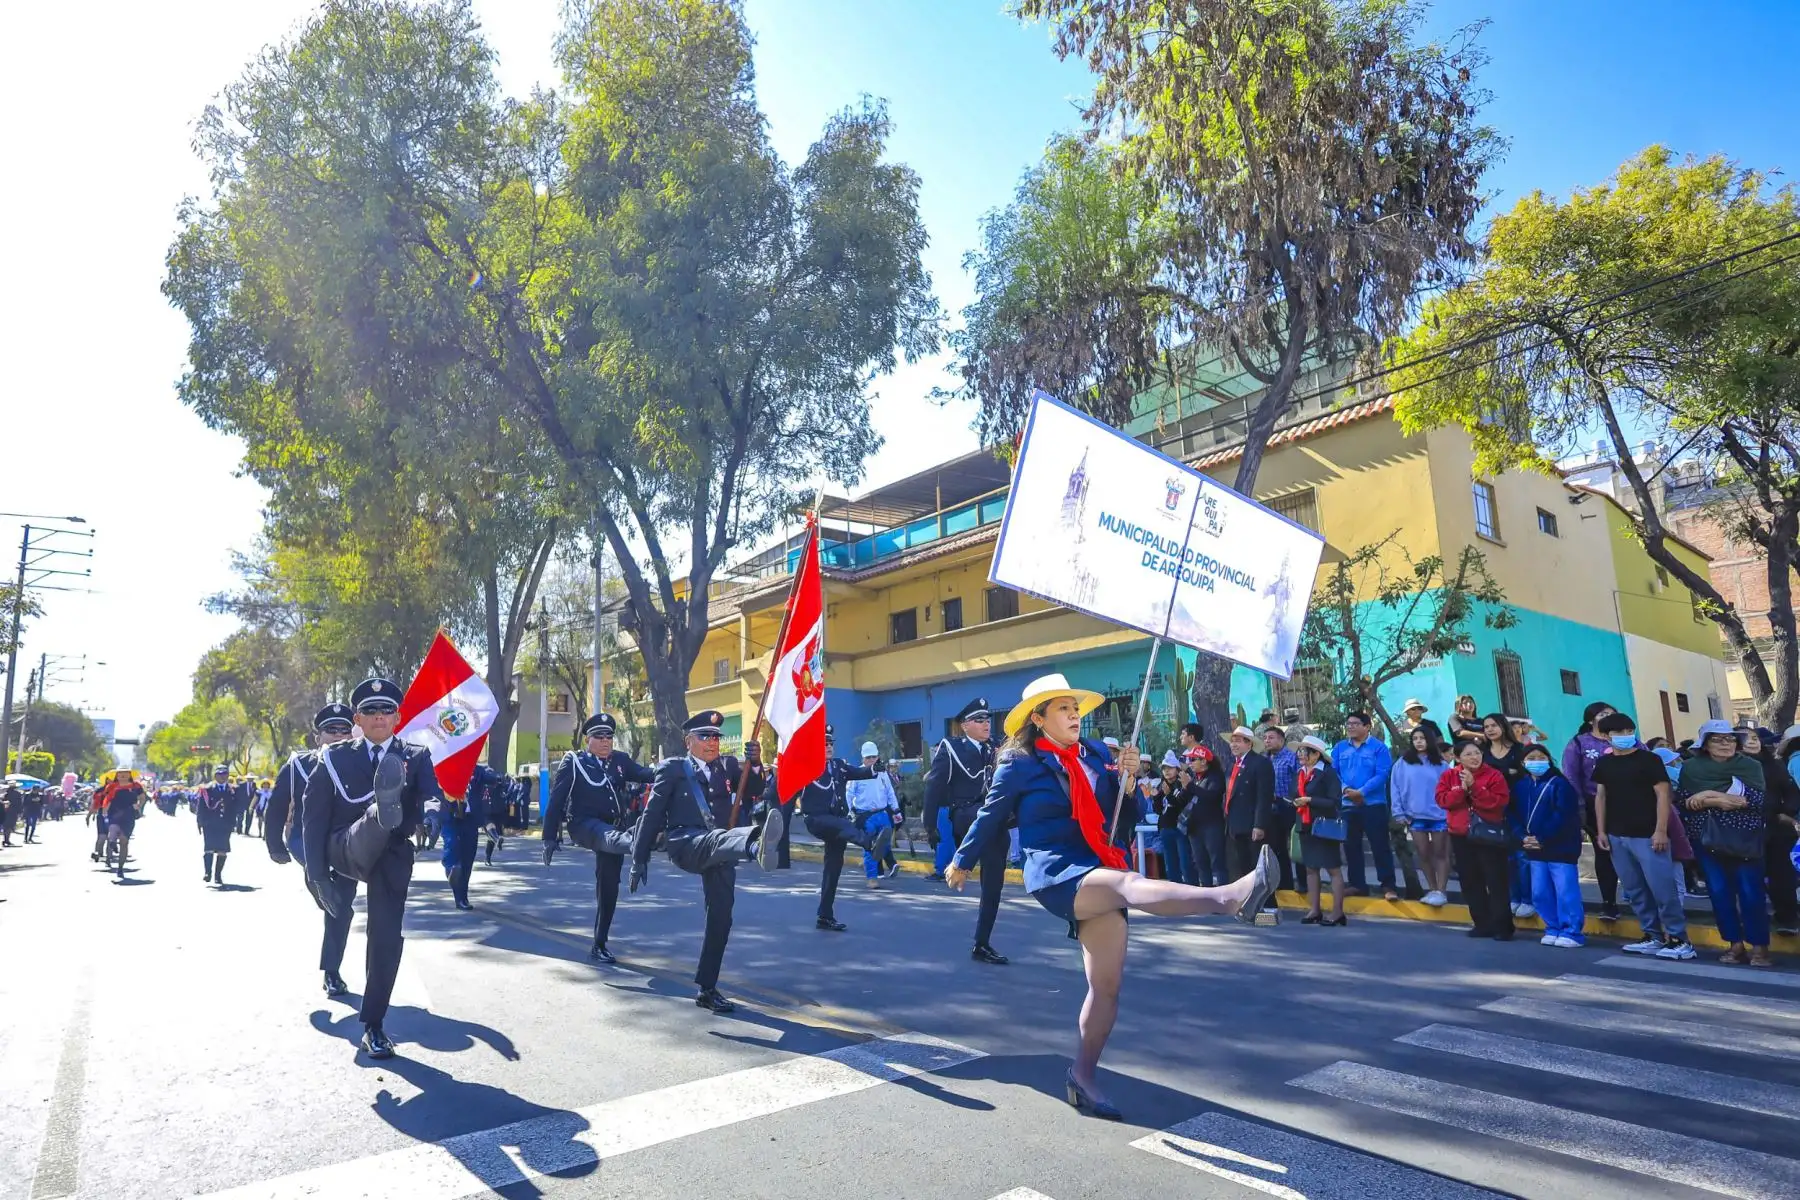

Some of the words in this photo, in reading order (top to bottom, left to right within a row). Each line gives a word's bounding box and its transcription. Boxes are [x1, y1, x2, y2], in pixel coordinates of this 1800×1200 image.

[1204, 506, 1218, 521] QUI
[1208, 519, 1218, 531] PA
[1098, 511, 1194, 564] MUNICIPALIDAD
[1194, 552, 1256, 592] PROVINCIAL
[1141, 550, 1160, 571] DE
[1158, 558, 1215, 594] AREQUIPA
